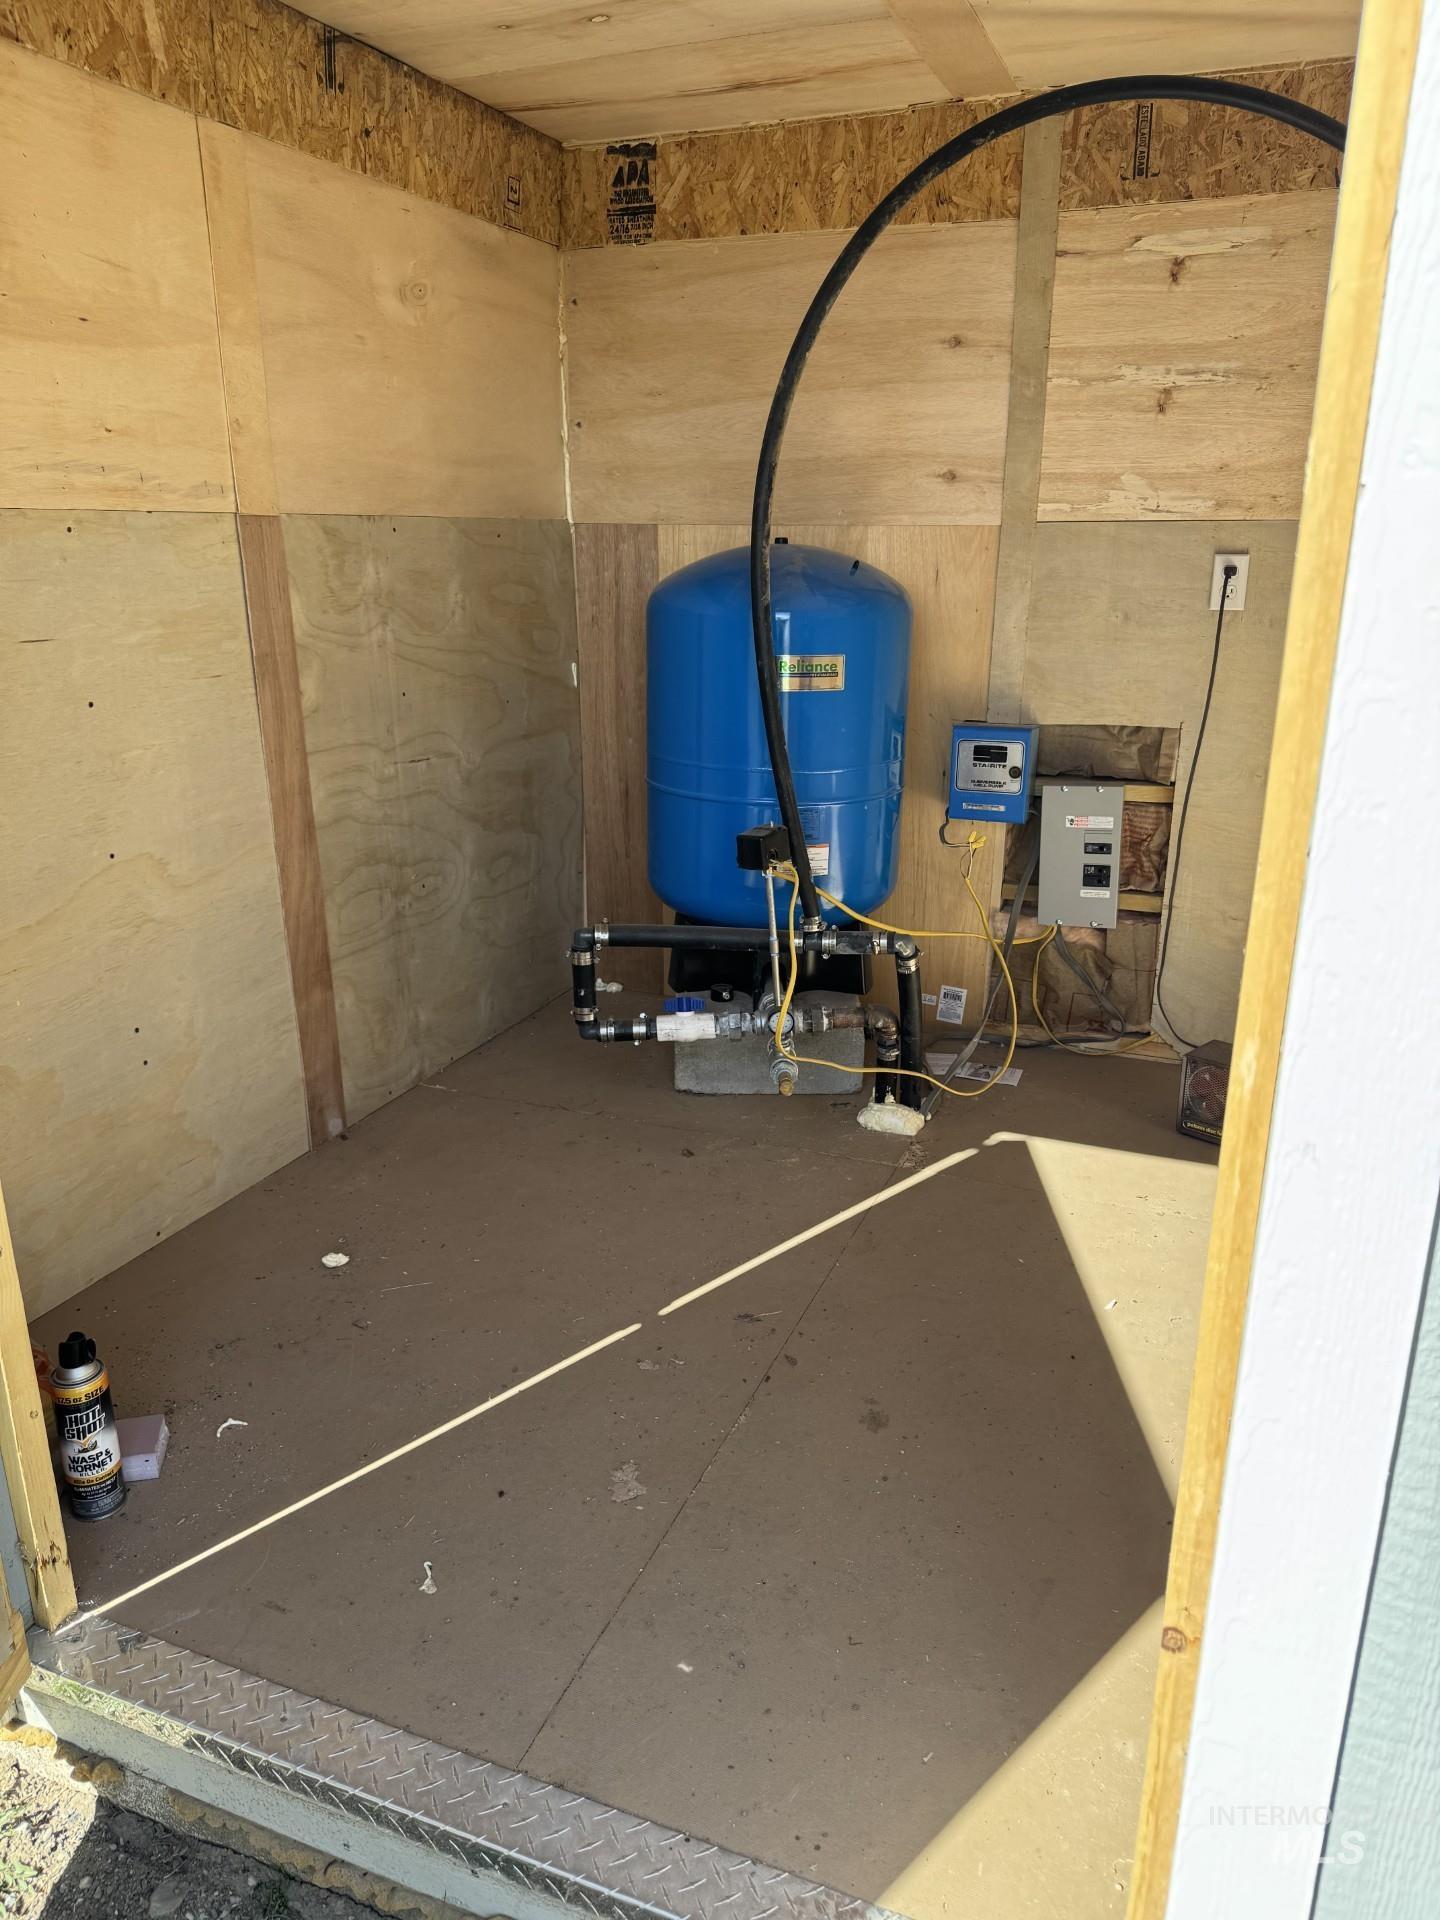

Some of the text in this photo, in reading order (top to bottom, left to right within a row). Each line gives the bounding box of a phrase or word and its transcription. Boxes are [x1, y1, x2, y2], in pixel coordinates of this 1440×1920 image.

[612, 160, 650, 188] APA
[779, 660, 838, 673] Reliance
[84, 1385, 105, 1400] SIZE
[66, 1404, 100, 1429] HOT
[65, 1412, 106, 1442] SHOT
[68, 1447, 111, 1465] WASP &
[68, 1453, 114, 1473] HORNET
